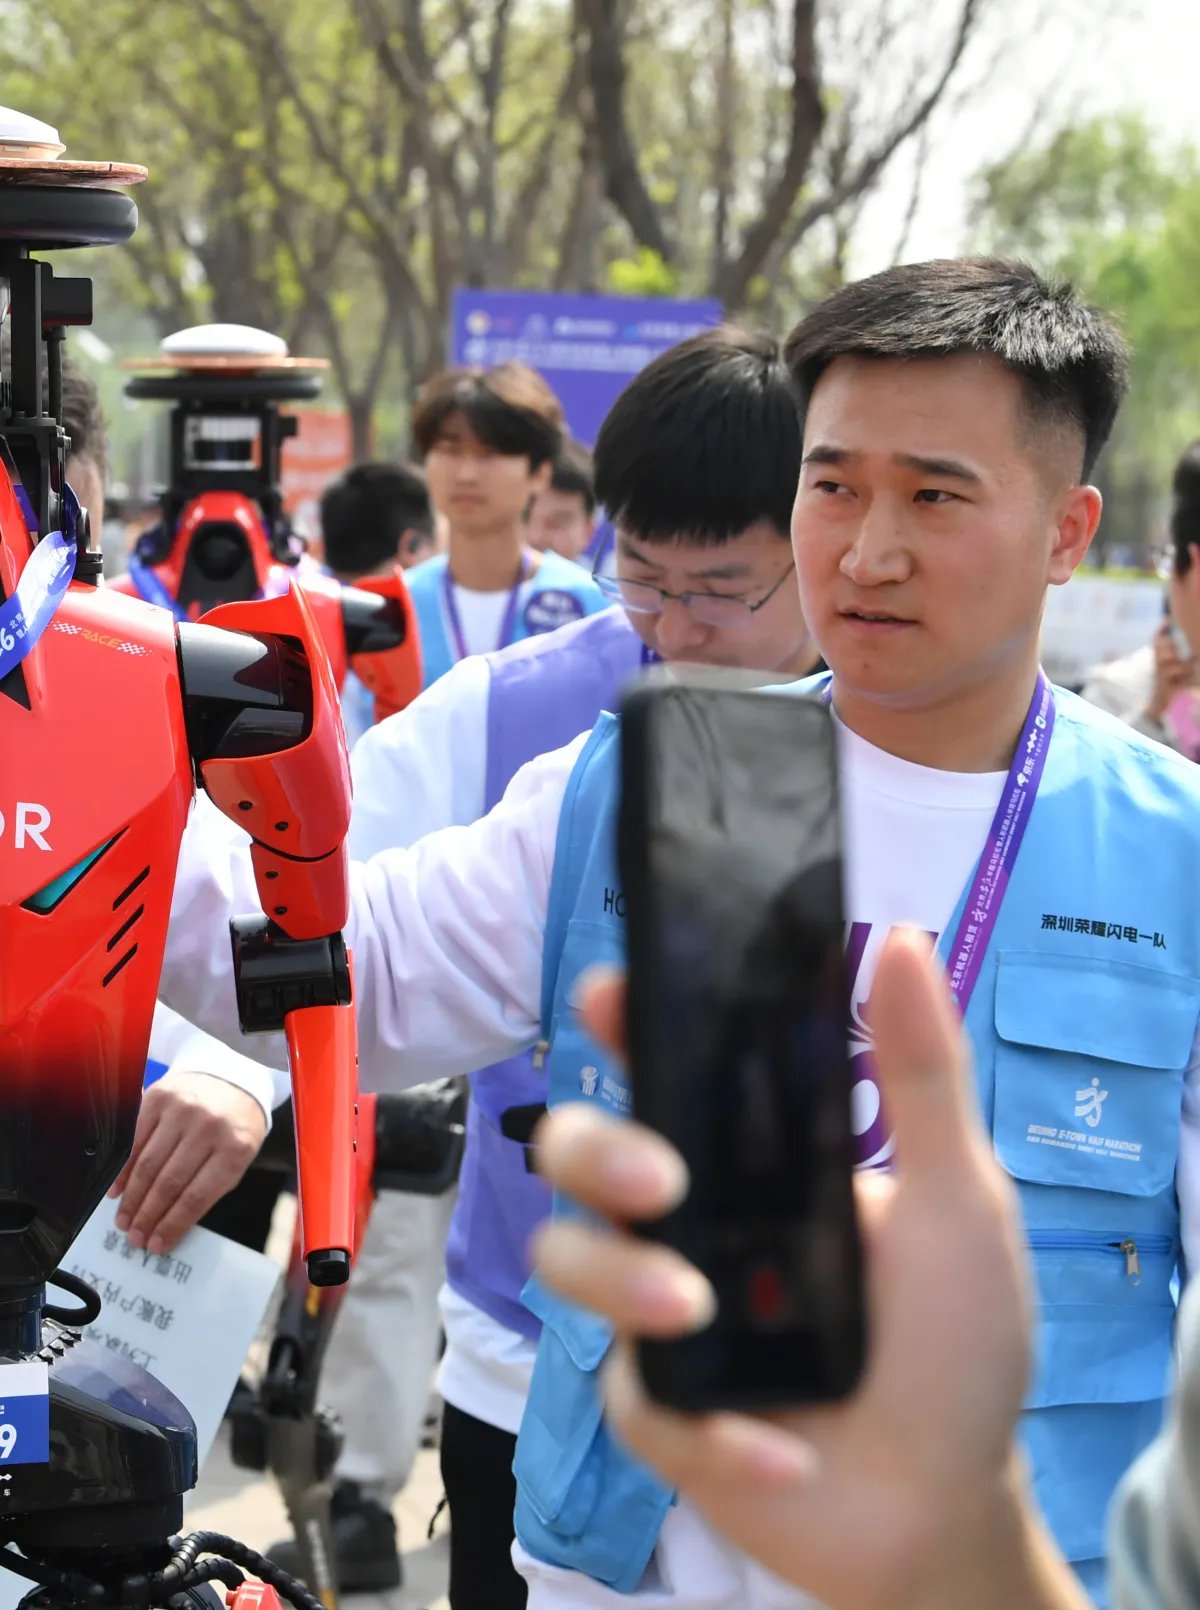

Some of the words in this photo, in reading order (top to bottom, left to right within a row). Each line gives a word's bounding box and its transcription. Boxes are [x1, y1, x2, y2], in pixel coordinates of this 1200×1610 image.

[81, 628, 122, 649] RACE
[1041, 914, 1166, 949] 深圳荣耀闪电一队
